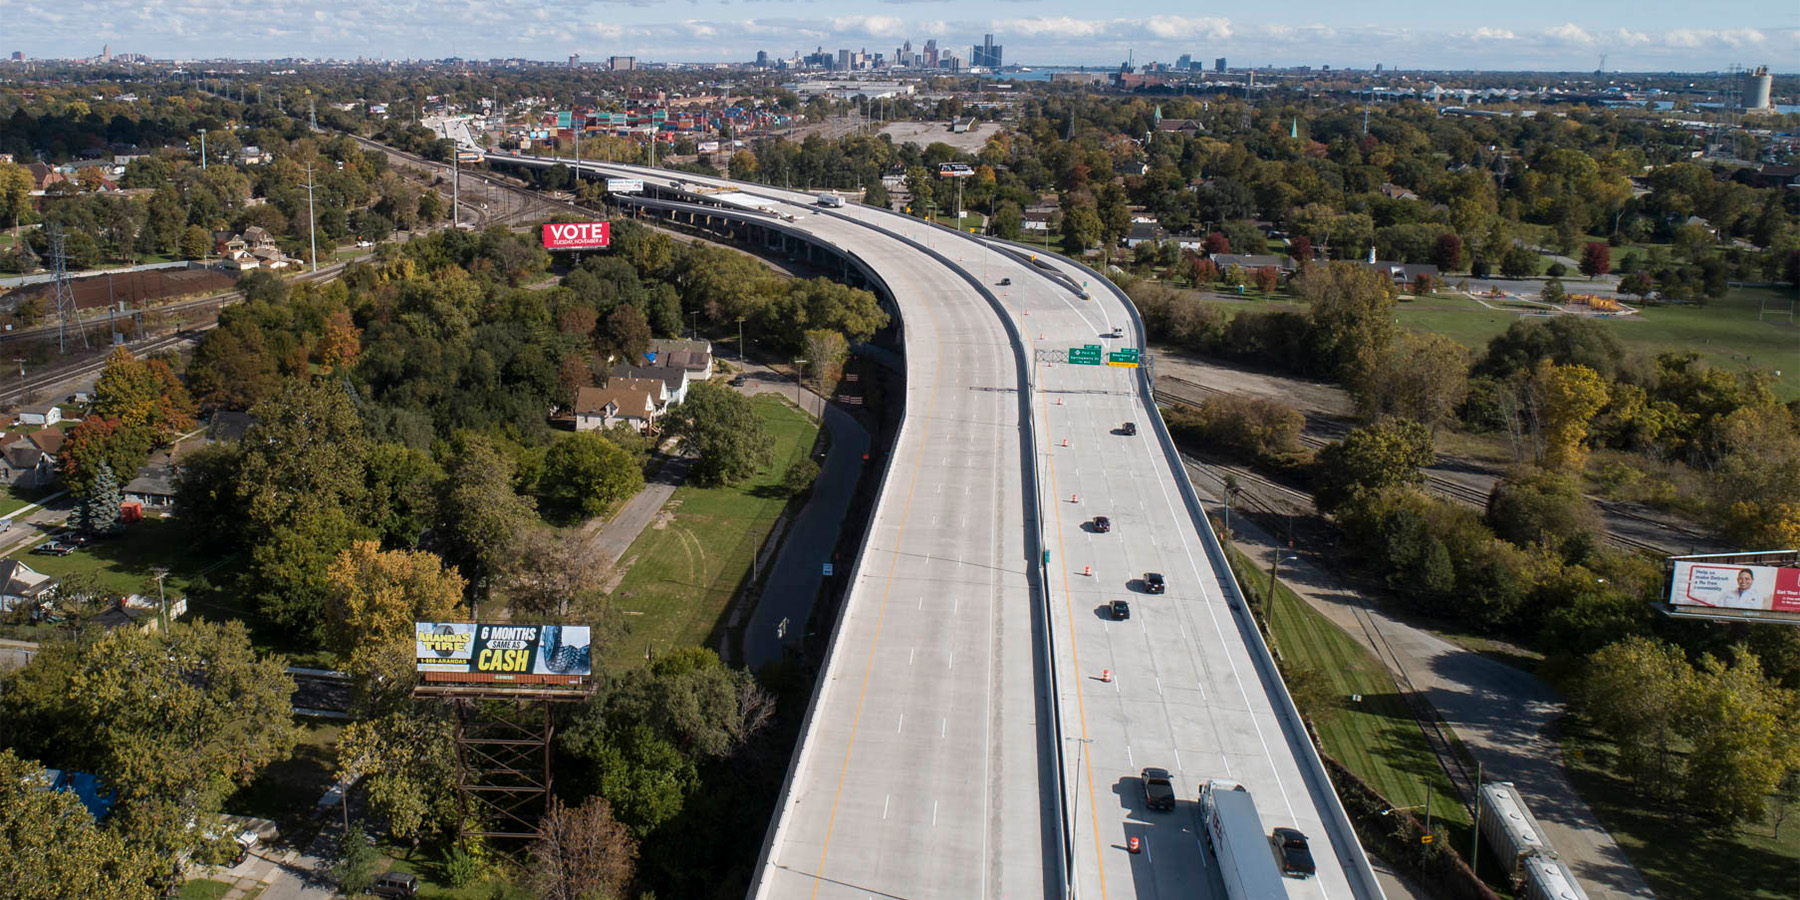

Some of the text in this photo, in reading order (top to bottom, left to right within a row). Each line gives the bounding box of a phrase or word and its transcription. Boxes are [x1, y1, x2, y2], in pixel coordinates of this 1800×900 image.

[550, 223, 603, 240] VOTE
[417, 631, 471, 643] ARANDAS
[481, 626, 537, 641] 6 MONTHS
[421, 641, 466, 652] TIRE
[492, 640, 521, 649] SAME AS
[477, 648, 530, 672] CASH
